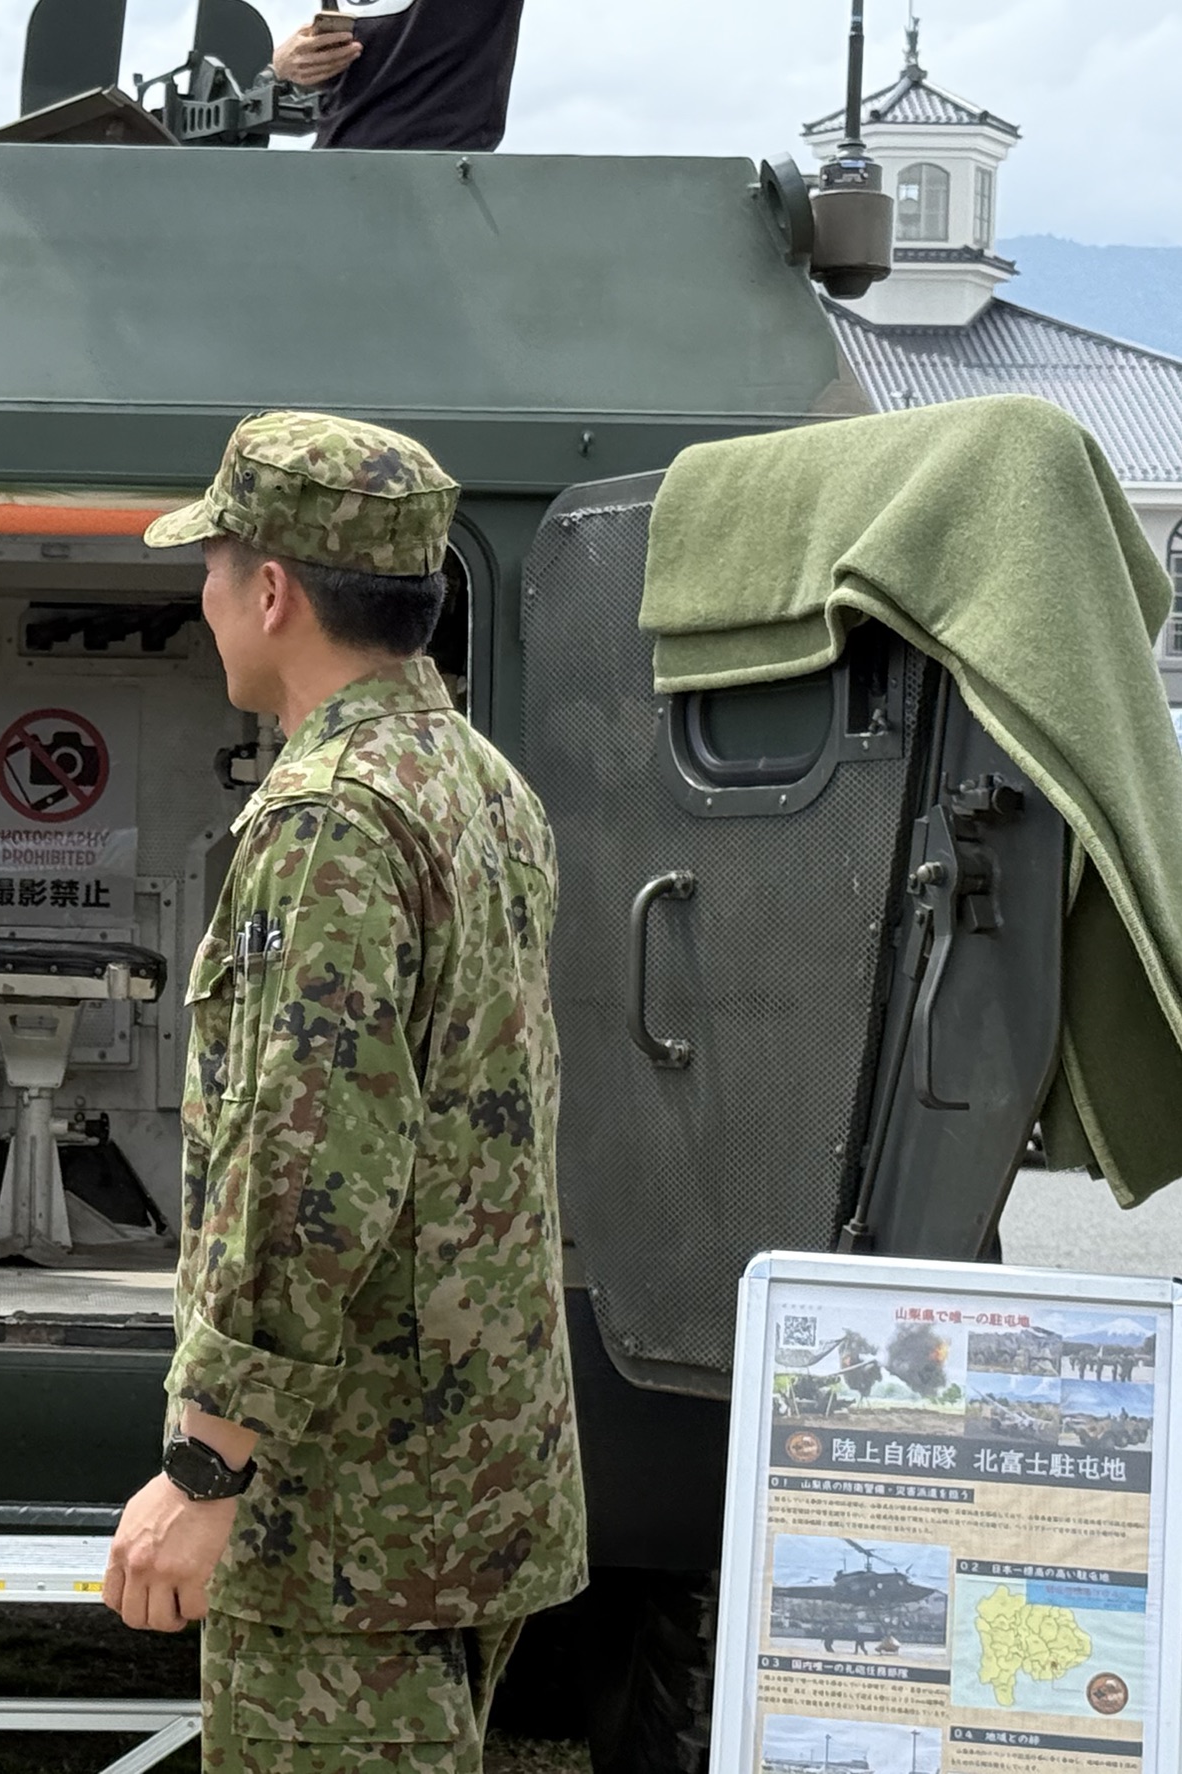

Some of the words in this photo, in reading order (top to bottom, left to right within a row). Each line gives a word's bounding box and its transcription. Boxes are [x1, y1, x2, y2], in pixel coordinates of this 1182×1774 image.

[2, 848, 96, 866] PROHIBITED
[895, 1306, 1031, 1328] 山梨県で唯一の駐屯地
[831, 1437, 957, 1470] 陸上自衛隊
[973, 1447, 1127, 1482] 北富士駐屯地
